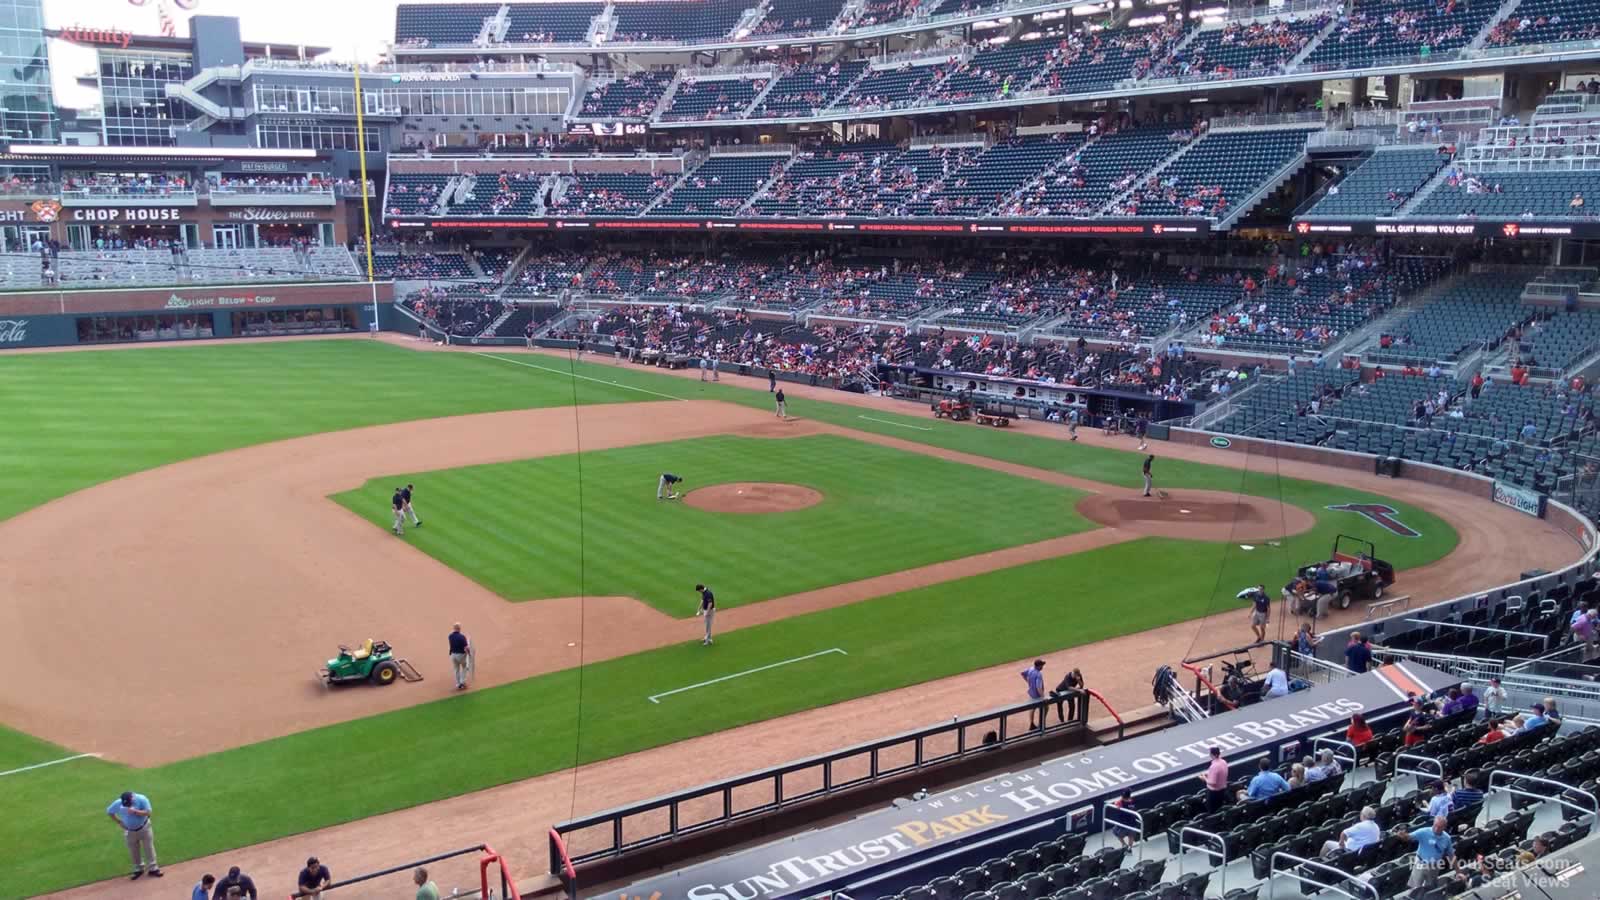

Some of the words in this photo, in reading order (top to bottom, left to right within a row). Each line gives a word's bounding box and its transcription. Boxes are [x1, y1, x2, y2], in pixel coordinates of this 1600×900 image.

[625, 124, 646, 134] 6:45
[74, 209, 120, 221] CHOP
[126, 208, 180, 220] HOUSE
[228, 211, 242, 219] THE
[243, 206, 289, 220] Silver
[1376, 224, 1397, 233] WE'LL
[1398, 225, 1415, 233] QUIT
[1416, 225, 1437, 233] WHEN
[1439, 225, 1455, 234] YOU
[1456, 225, 1475, 234] QUIT
[255, 296, 276, 304] CHOP
[1517, 498, 1538, 514] LIGHT
[1000, 765, 1137, 813] HOME
[1131, 750, 1183, 783] OF
[1176, 729, 1254, 767] THE
[1237, 696, 1366, 748] BRAVES
[927, 768, 1051, 810] WELCOME
[1063, 756, 1094, 771] TO
